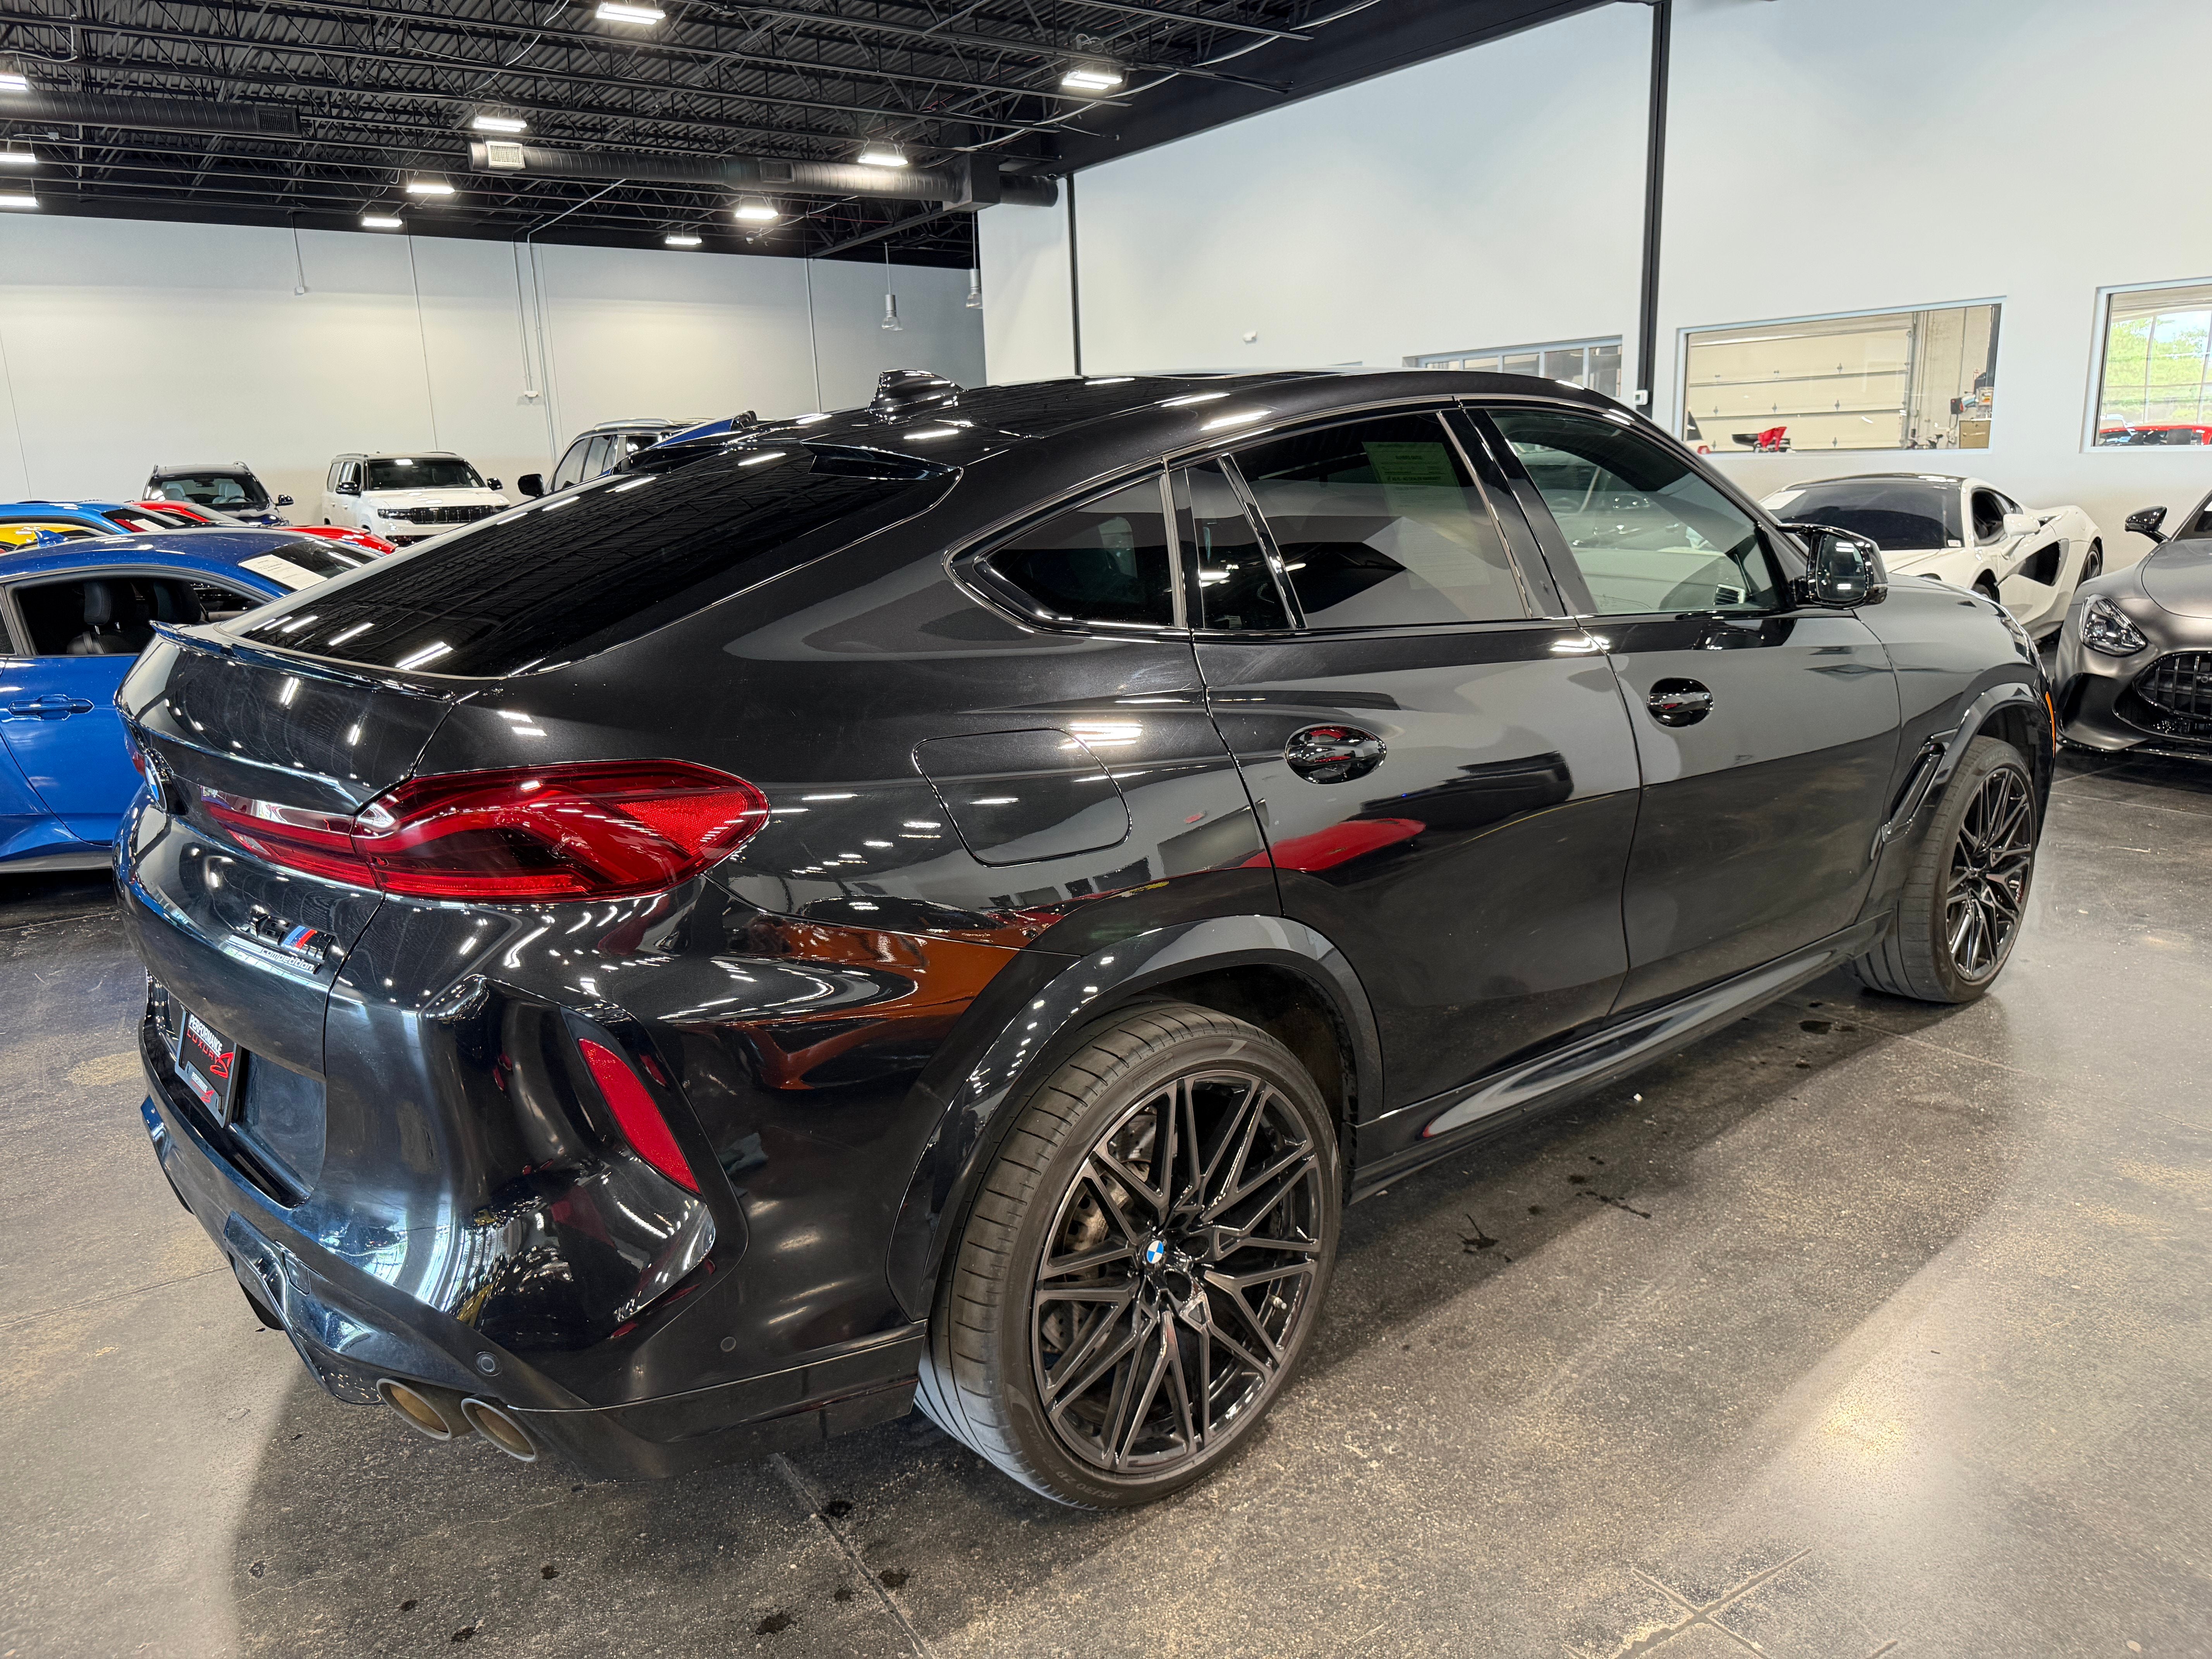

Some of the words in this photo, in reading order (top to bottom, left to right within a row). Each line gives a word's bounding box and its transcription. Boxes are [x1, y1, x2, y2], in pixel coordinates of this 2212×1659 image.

[261, 947, 315, 971] competition
[186, 1028, 220, 1065] LUXURY
[189, 1014, 223, 1056] PERFORMANCE
